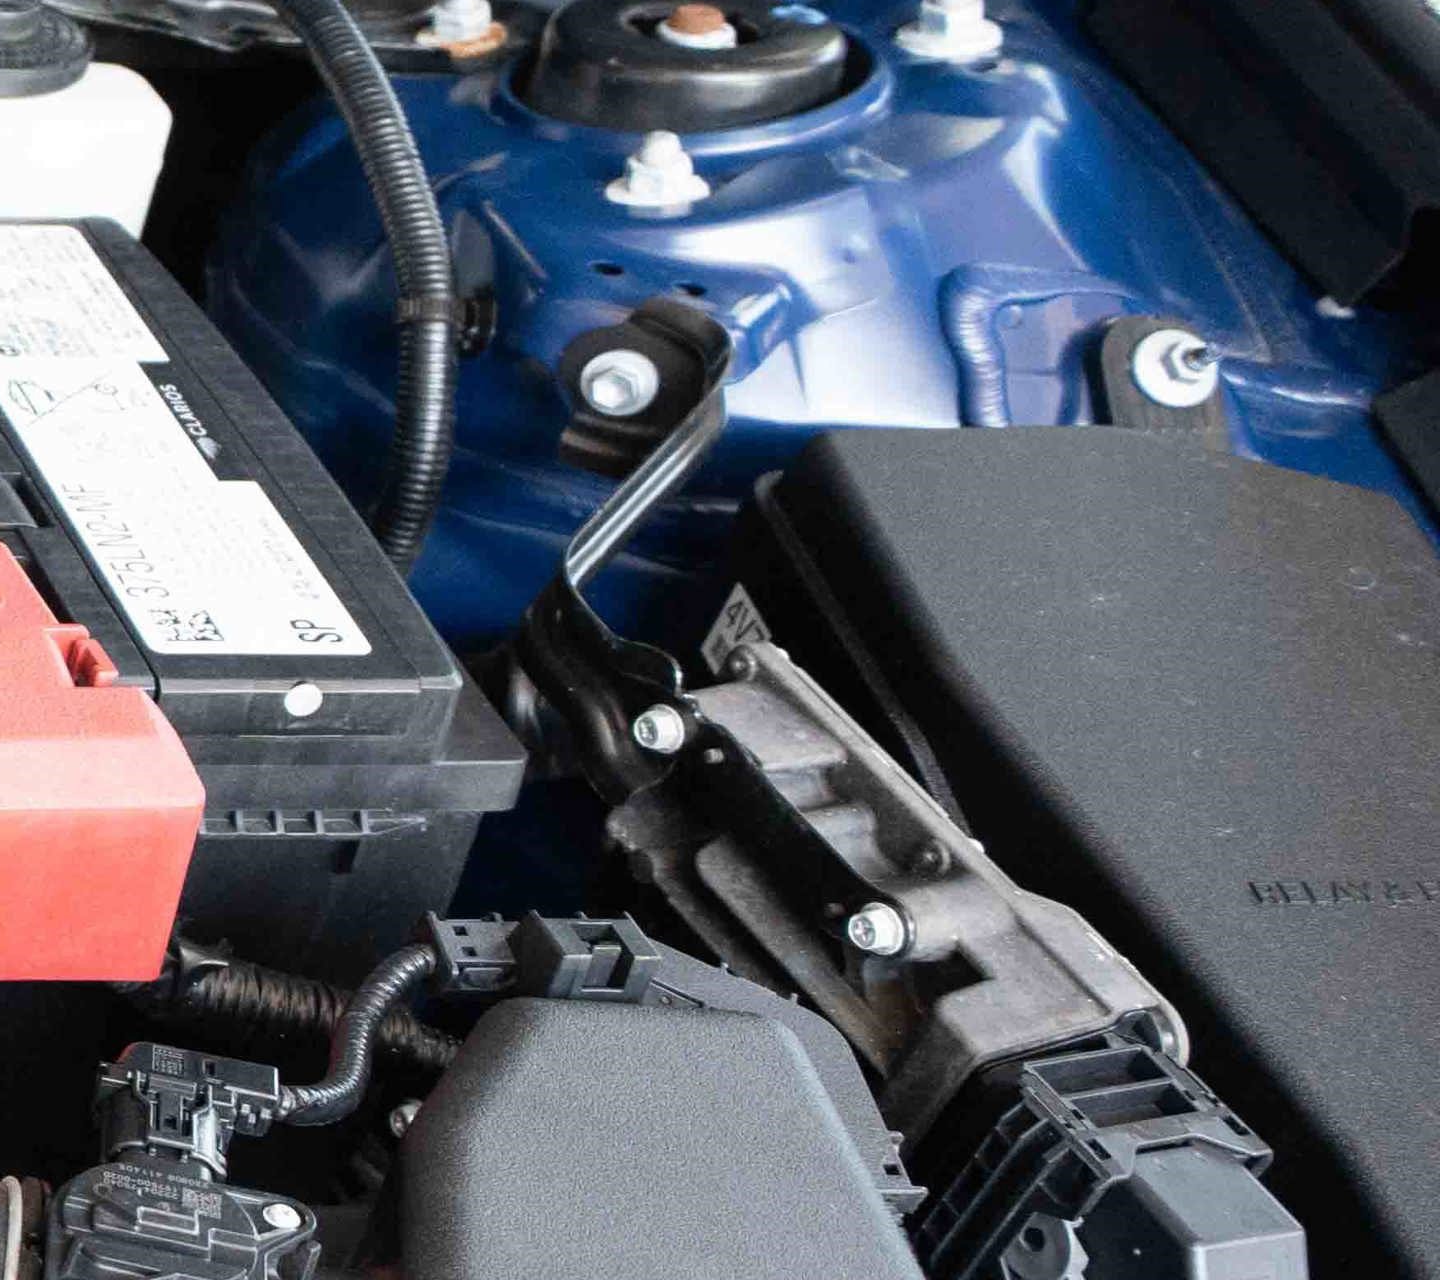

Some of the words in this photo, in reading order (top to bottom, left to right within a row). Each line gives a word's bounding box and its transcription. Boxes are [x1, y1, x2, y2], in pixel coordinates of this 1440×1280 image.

[161, 383, 207, 437] CLARIOS
[289, 618, 344, 644] SP
[1248, 880, 1373, 904] RELAY
